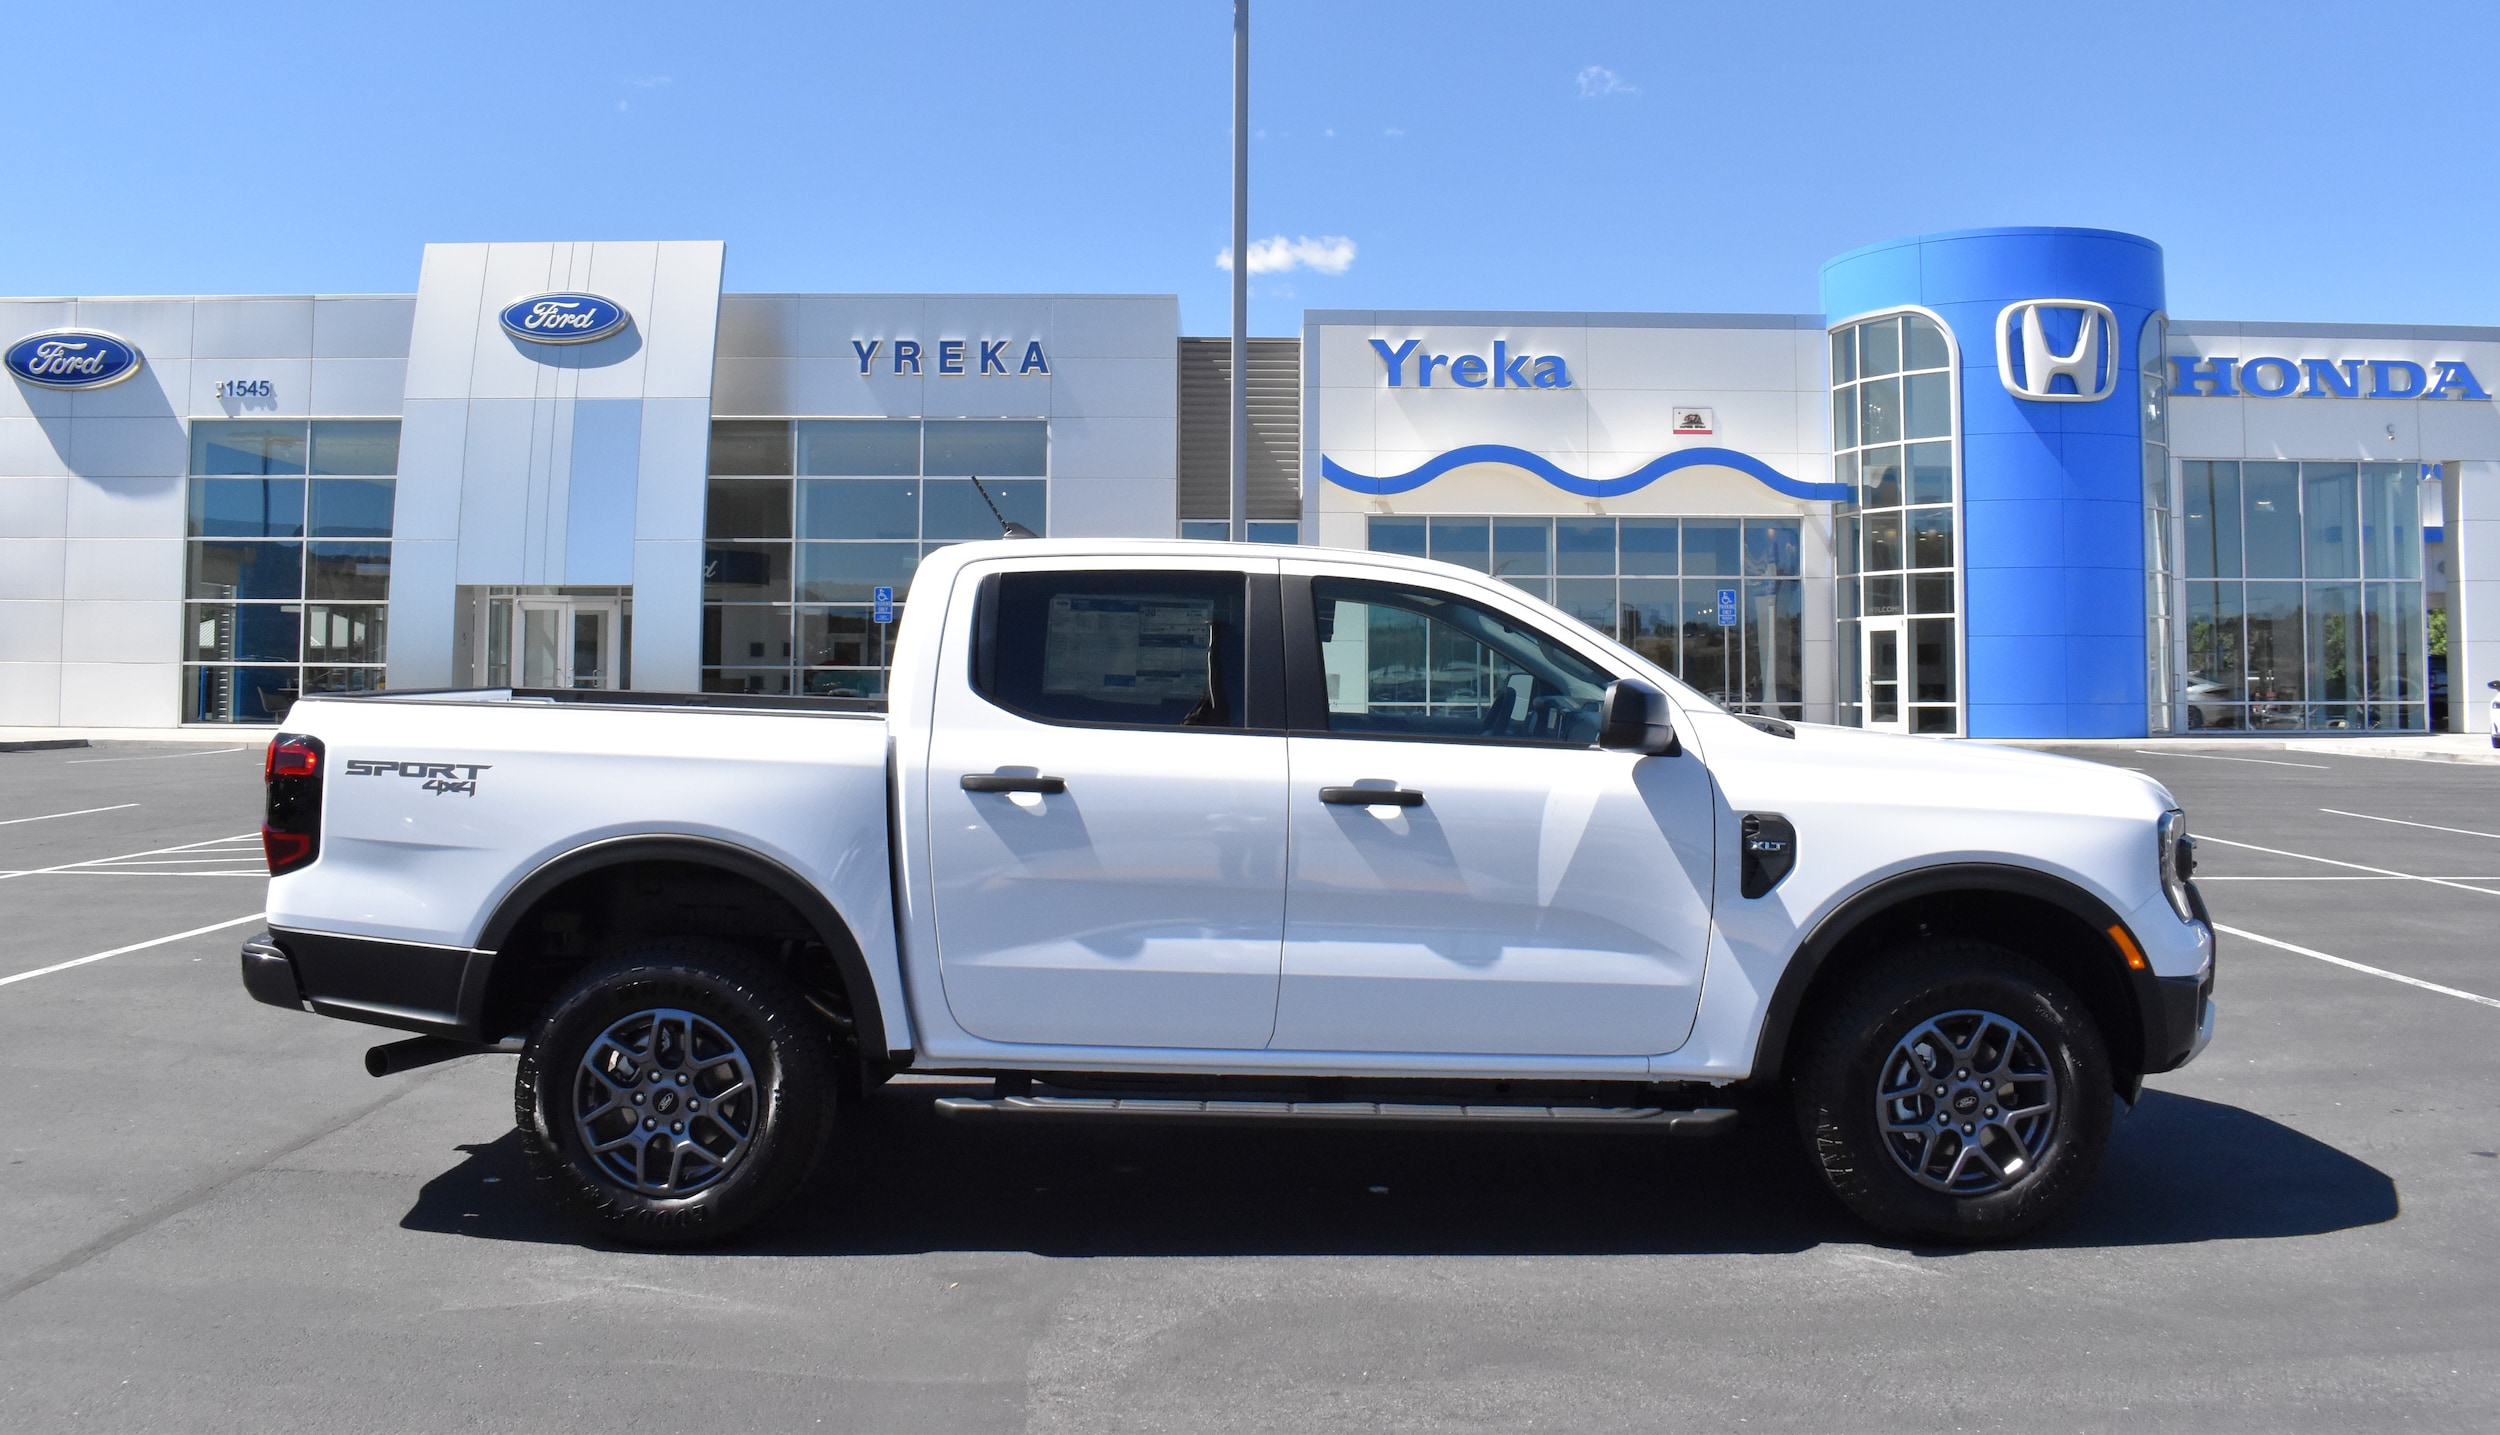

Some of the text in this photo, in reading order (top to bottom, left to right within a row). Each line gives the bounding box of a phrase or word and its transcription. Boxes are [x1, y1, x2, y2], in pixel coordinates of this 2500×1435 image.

[525, 302, 597, 328] Ford
[29, 341, 106, 374] Ford
[851, 340, 1050, 375] YREKA
[1368, 339, 1572, 388] Yreka
[226, 380, 270, 397] 1545
[2168, 356, 2492, 400] HONDA
[345, 760, 493, 780] SPORT
[422, 779, 476, 798] 4x4
[1750, 841, 1786, 850] XLT
